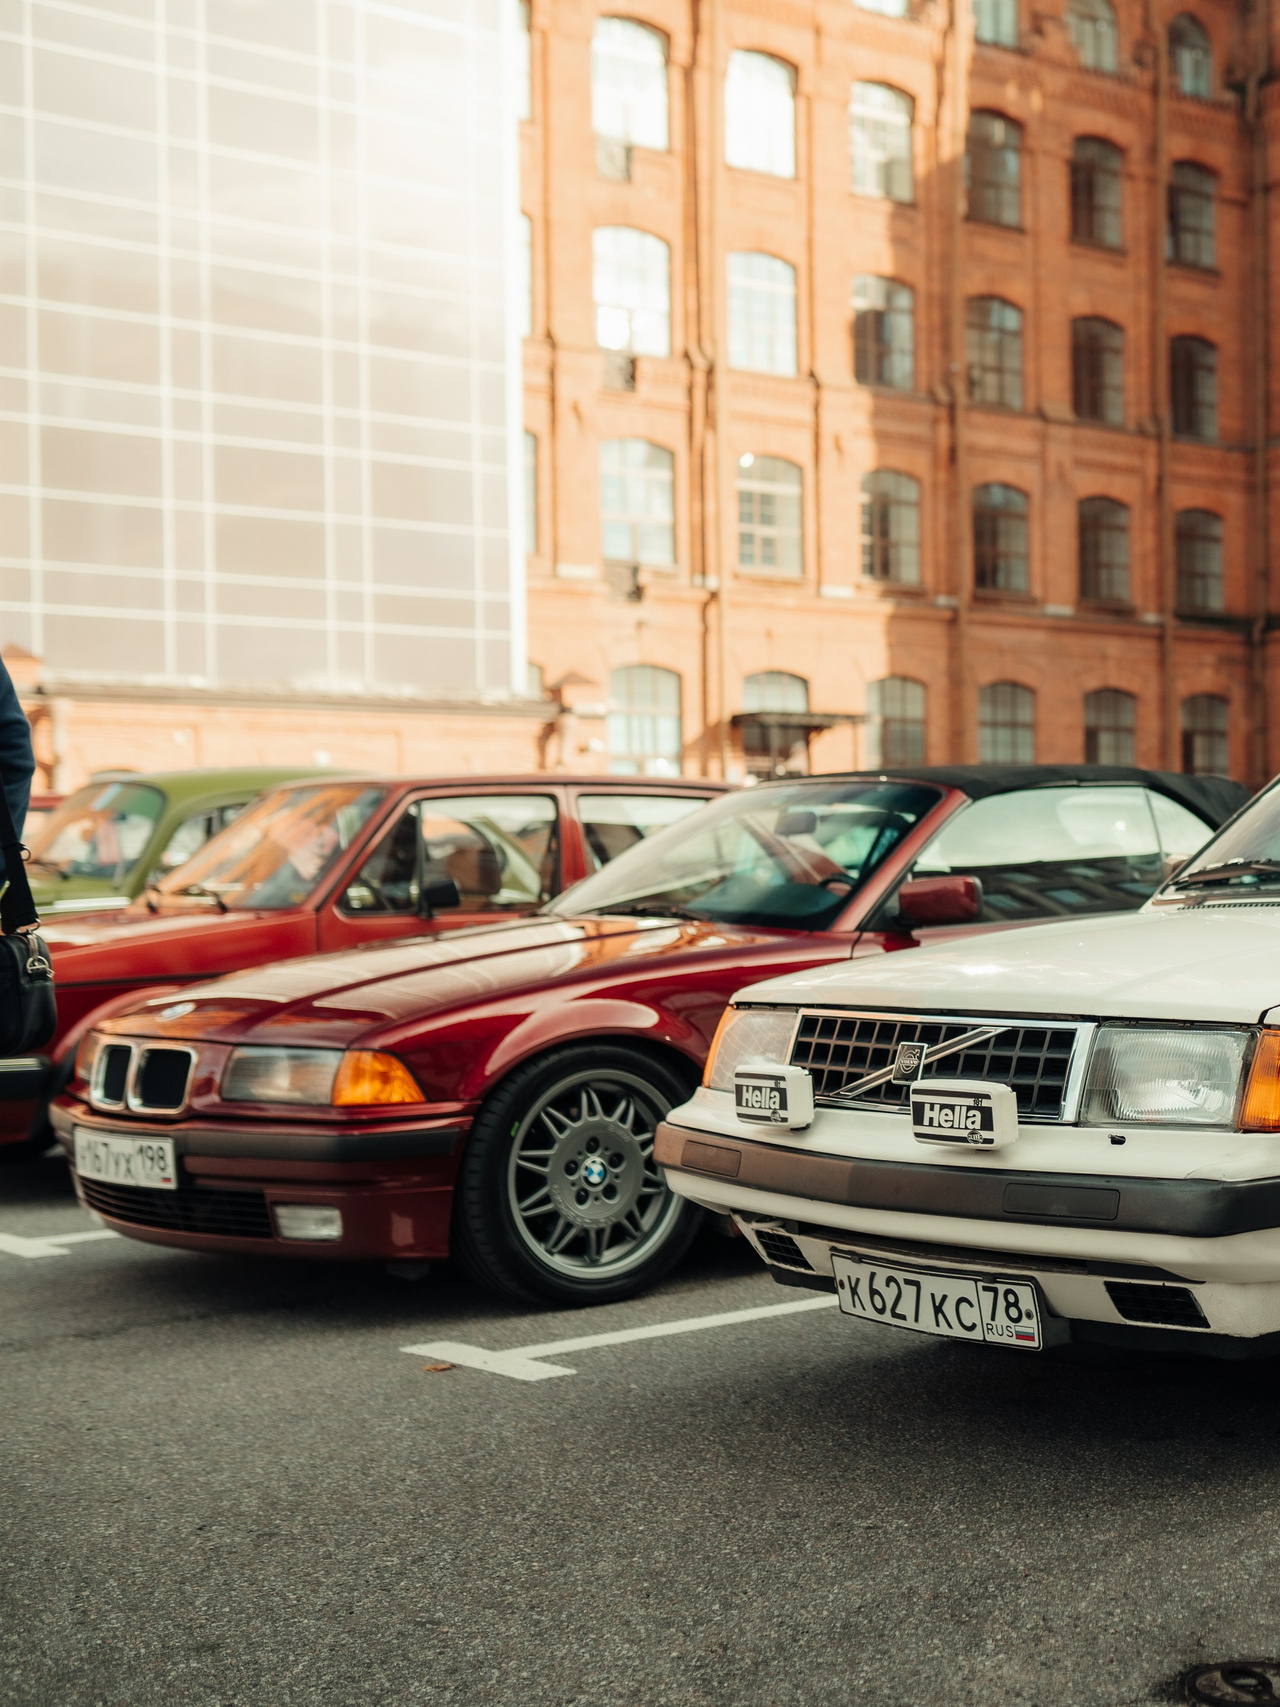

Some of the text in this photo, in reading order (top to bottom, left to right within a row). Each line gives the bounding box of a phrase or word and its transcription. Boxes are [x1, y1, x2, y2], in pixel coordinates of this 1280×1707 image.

[742, 1085, 780, 1110] Hella
[923, 1103, 982, 1131] Hella
[136, 1145, 167, 1171] 198
[982, 1285, 1023, 1324] 78
[986, 1323, 1014, 1338] RUS
